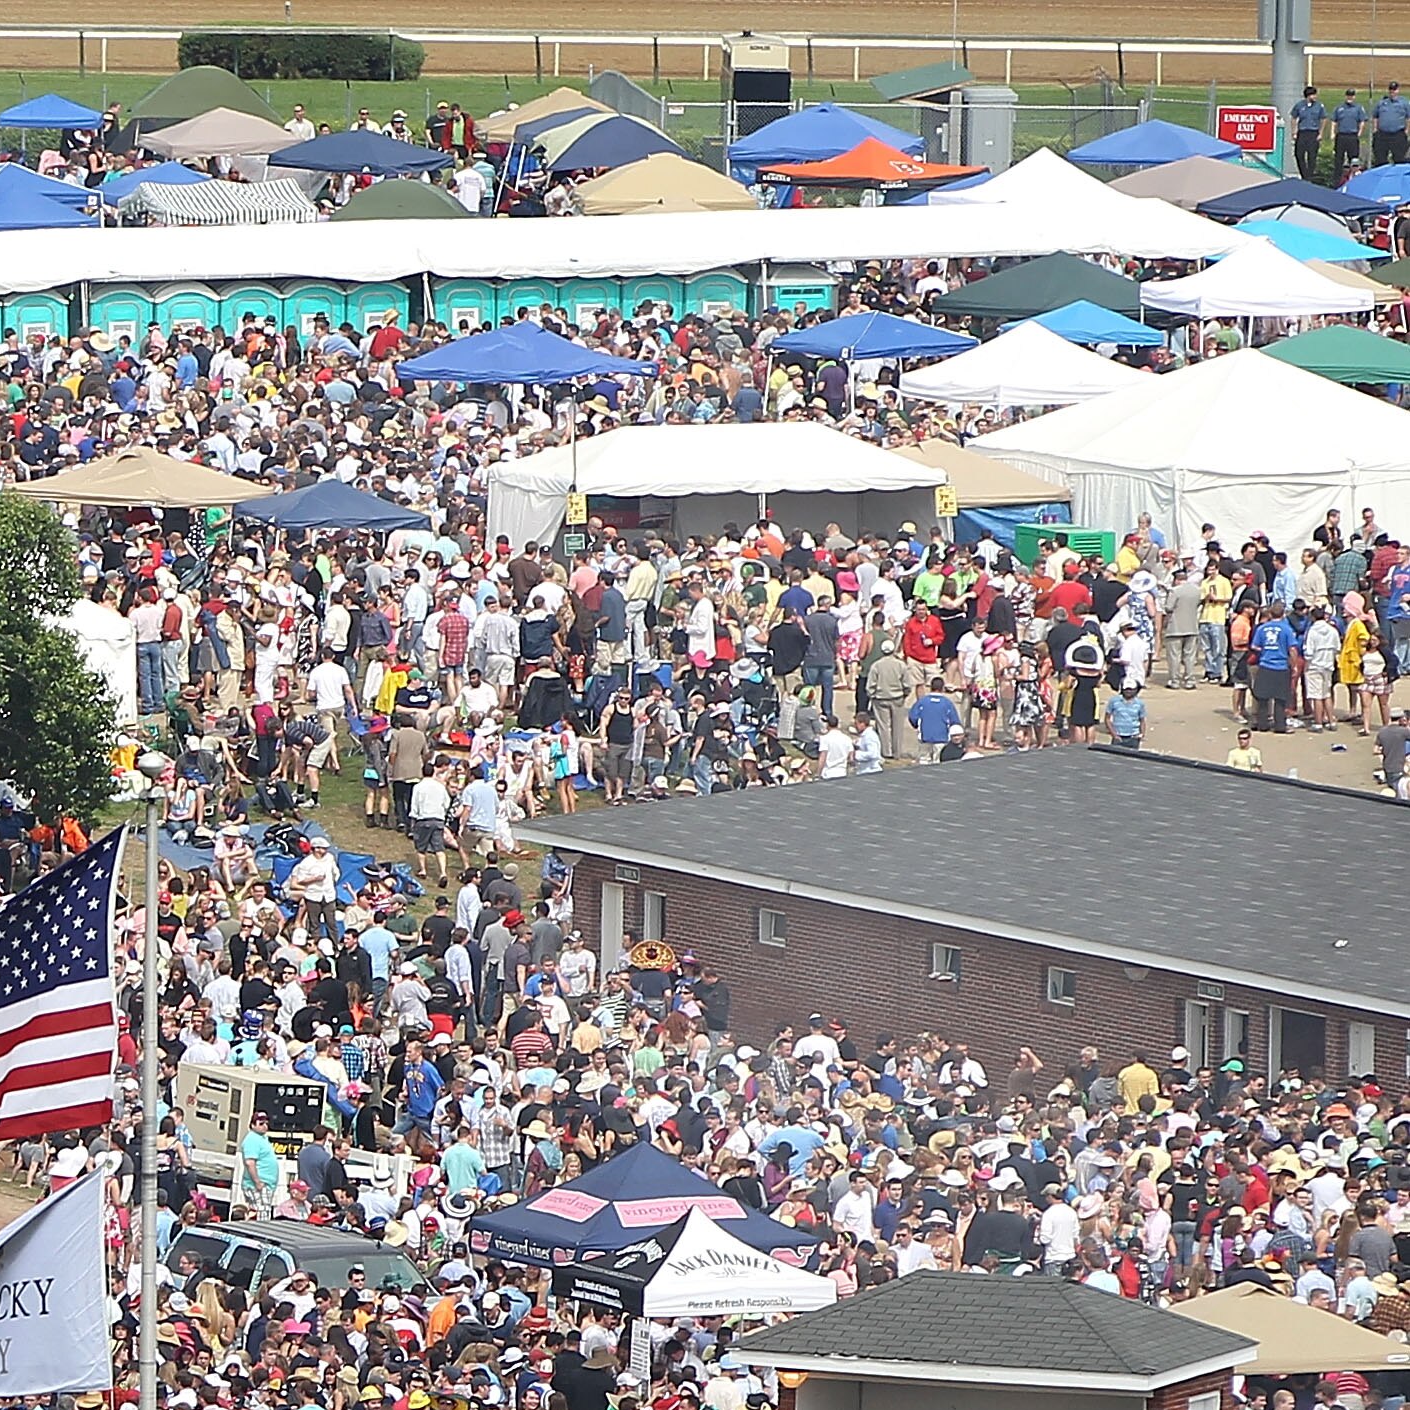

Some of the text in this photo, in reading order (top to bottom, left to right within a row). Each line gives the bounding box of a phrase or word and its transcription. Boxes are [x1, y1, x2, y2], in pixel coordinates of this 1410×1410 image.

[1224, 113, 1269, 123] EMERGENCY
[1237, 123, 1255, 131] EXIT
[1235, 132, 1256, 141] ONLY
[623, 1204, 687, 1219] vineyard
[494, 1237, 550, 1261] vineyard vines
[667, 1257, 704, 1277] JACK
[687, 1297, 793, 1309] Please Refresh Responsibly
